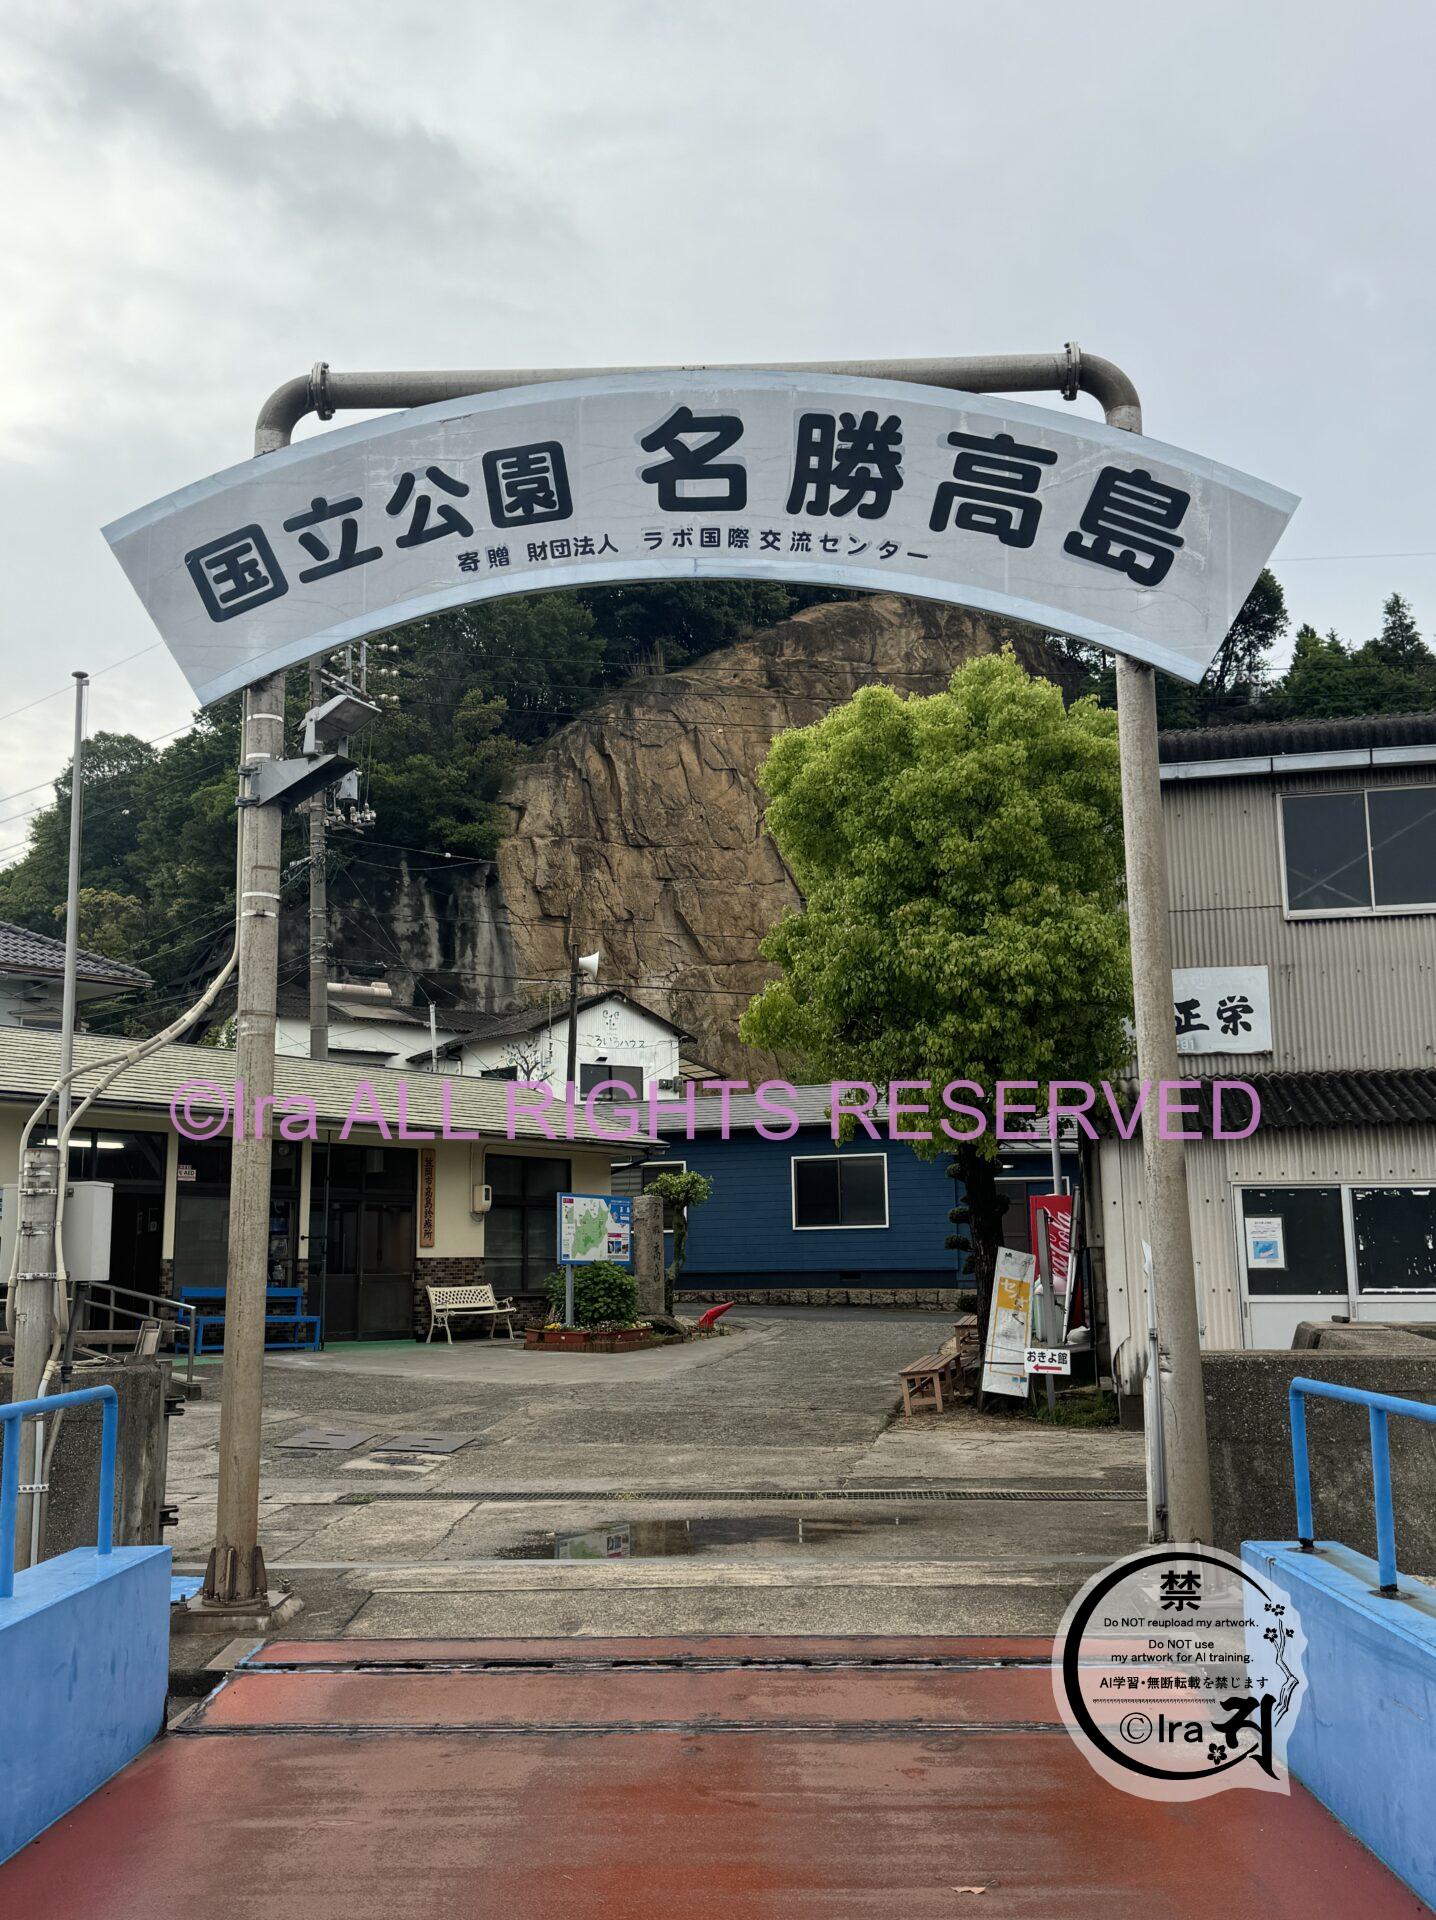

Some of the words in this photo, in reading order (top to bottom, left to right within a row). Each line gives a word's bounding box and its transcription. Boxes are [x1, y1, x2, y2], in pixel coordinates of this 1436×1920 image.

[184, 440, 574, 623] 国立公園
[641, 406, 1191, 587] 名勝高島
[457, 546, 510, 572] 寄贈
[527, 534, 619, 562] 財団法人
[644, 528, 929, 560] ラボ国際交流センター
[1026, 1351, 1068, 1365] おきよ館
